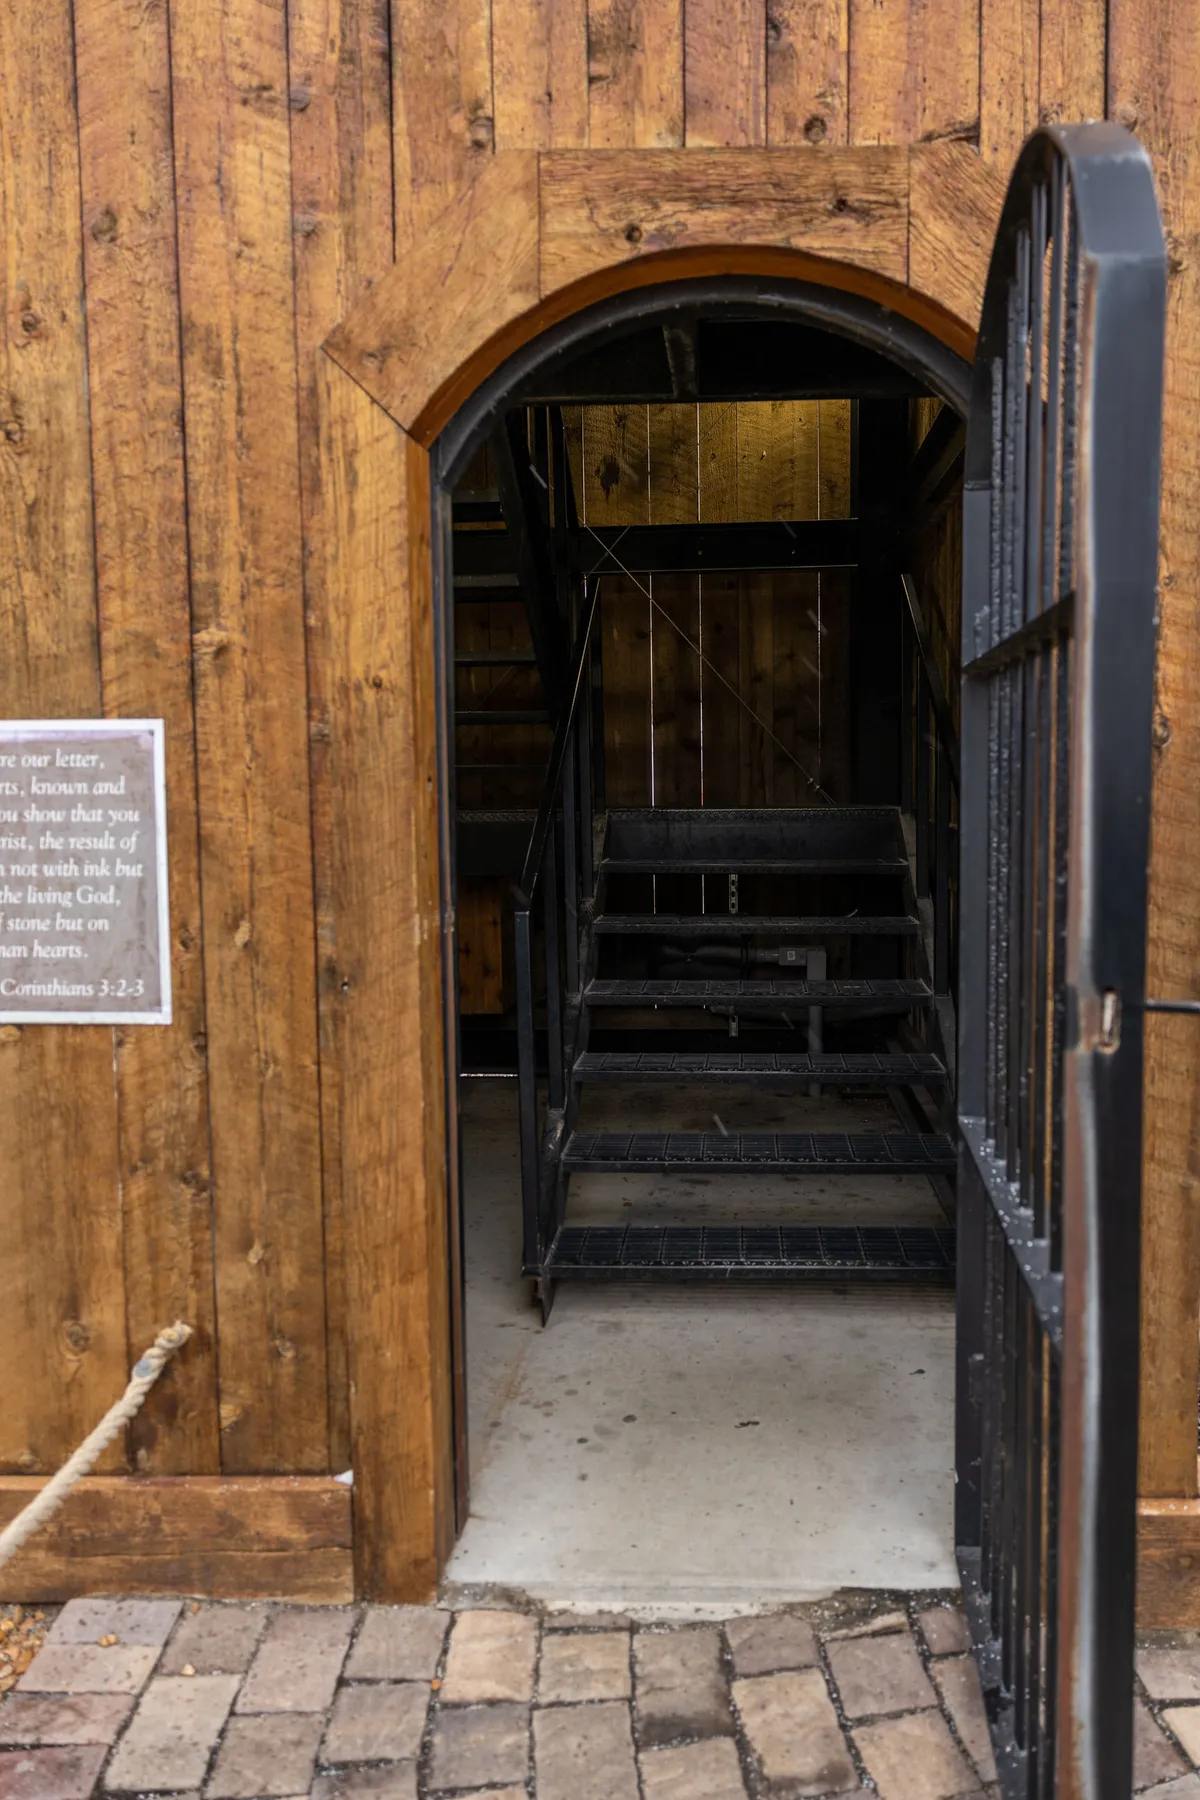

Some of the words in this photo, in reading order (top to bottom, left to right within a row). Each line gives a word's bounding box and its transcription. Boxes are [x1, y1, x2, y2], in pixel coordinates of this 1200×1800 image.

[21, 754, 51, 768] our
[31, 776, 88, 795] known
[92, 775, 125, 795] and
[23, 803, 66, 822] show
[71, 803, 103, 822] that
[108, 809, 140, 827] you
[39, 831, 63, 850] the
[69, 830, 116, 850] result
[119, 831, 140, 854] of
[11, 862, 38, 877] not
[43, 857, 80, 877] with
[84, 857, 110, 877] ink
[115, 858, 143, 877] but
[27, 884, 72, 908] living
[77, 885, 121, 906] God,
[6, 917, 50, 931] stone
[55, 912, 83, 931] but
[87, 918, 110, 931] on
[32, 939, 88, 958] hearts.
[0, 978, 94, 996] Corinthians
[98, 979, 145, 997] 3:2-3
